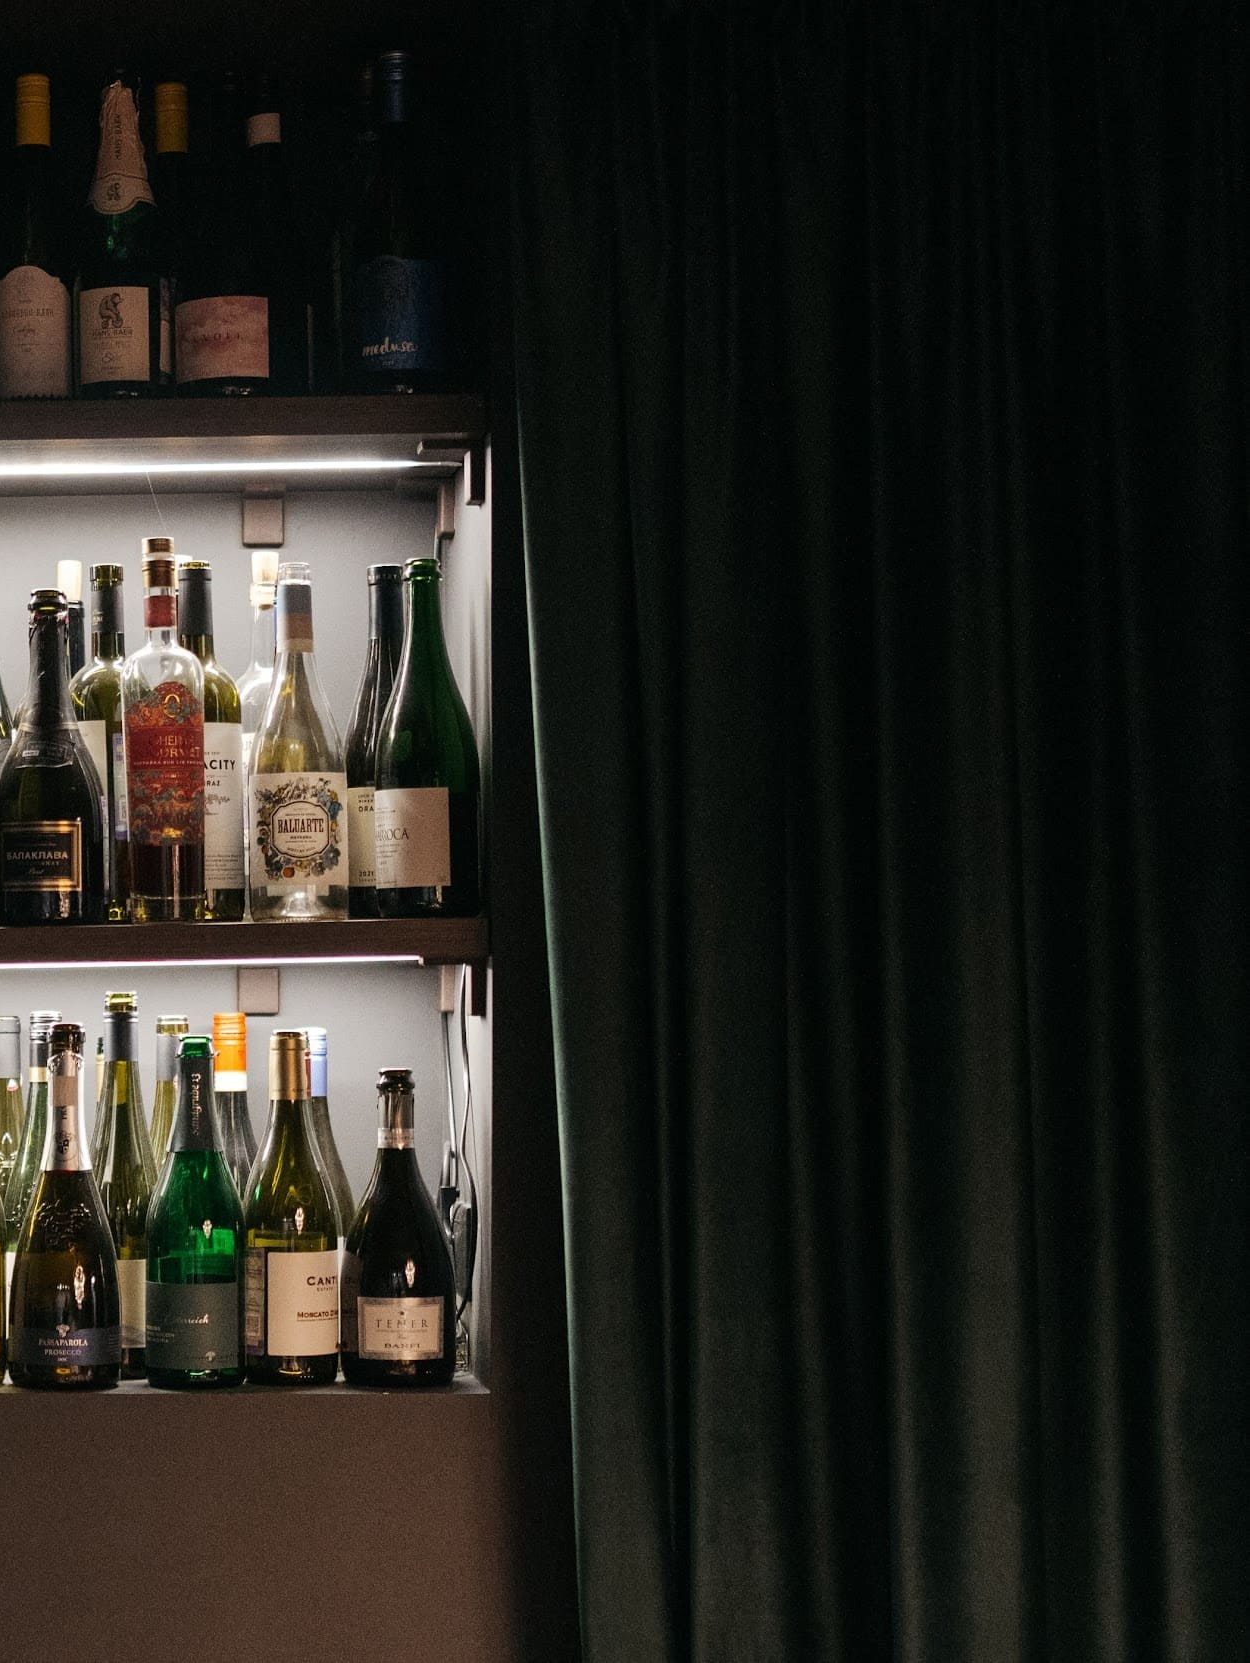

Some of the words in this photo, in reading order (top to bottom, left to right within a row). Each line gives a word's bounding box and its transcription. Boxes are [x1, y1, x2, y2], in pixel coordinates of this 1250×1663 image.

[203, 759, 236, 771] ACITY
[277, 818, 324, 834] BALUARTE
[6, 851, 69, 861] БАЛАКЛАВА
[307, 1276, 338, 1286] CANT
[374, 1319, 429, 1329] TENER
[38, 1338, 88, 1347] PASSAPAROLA
